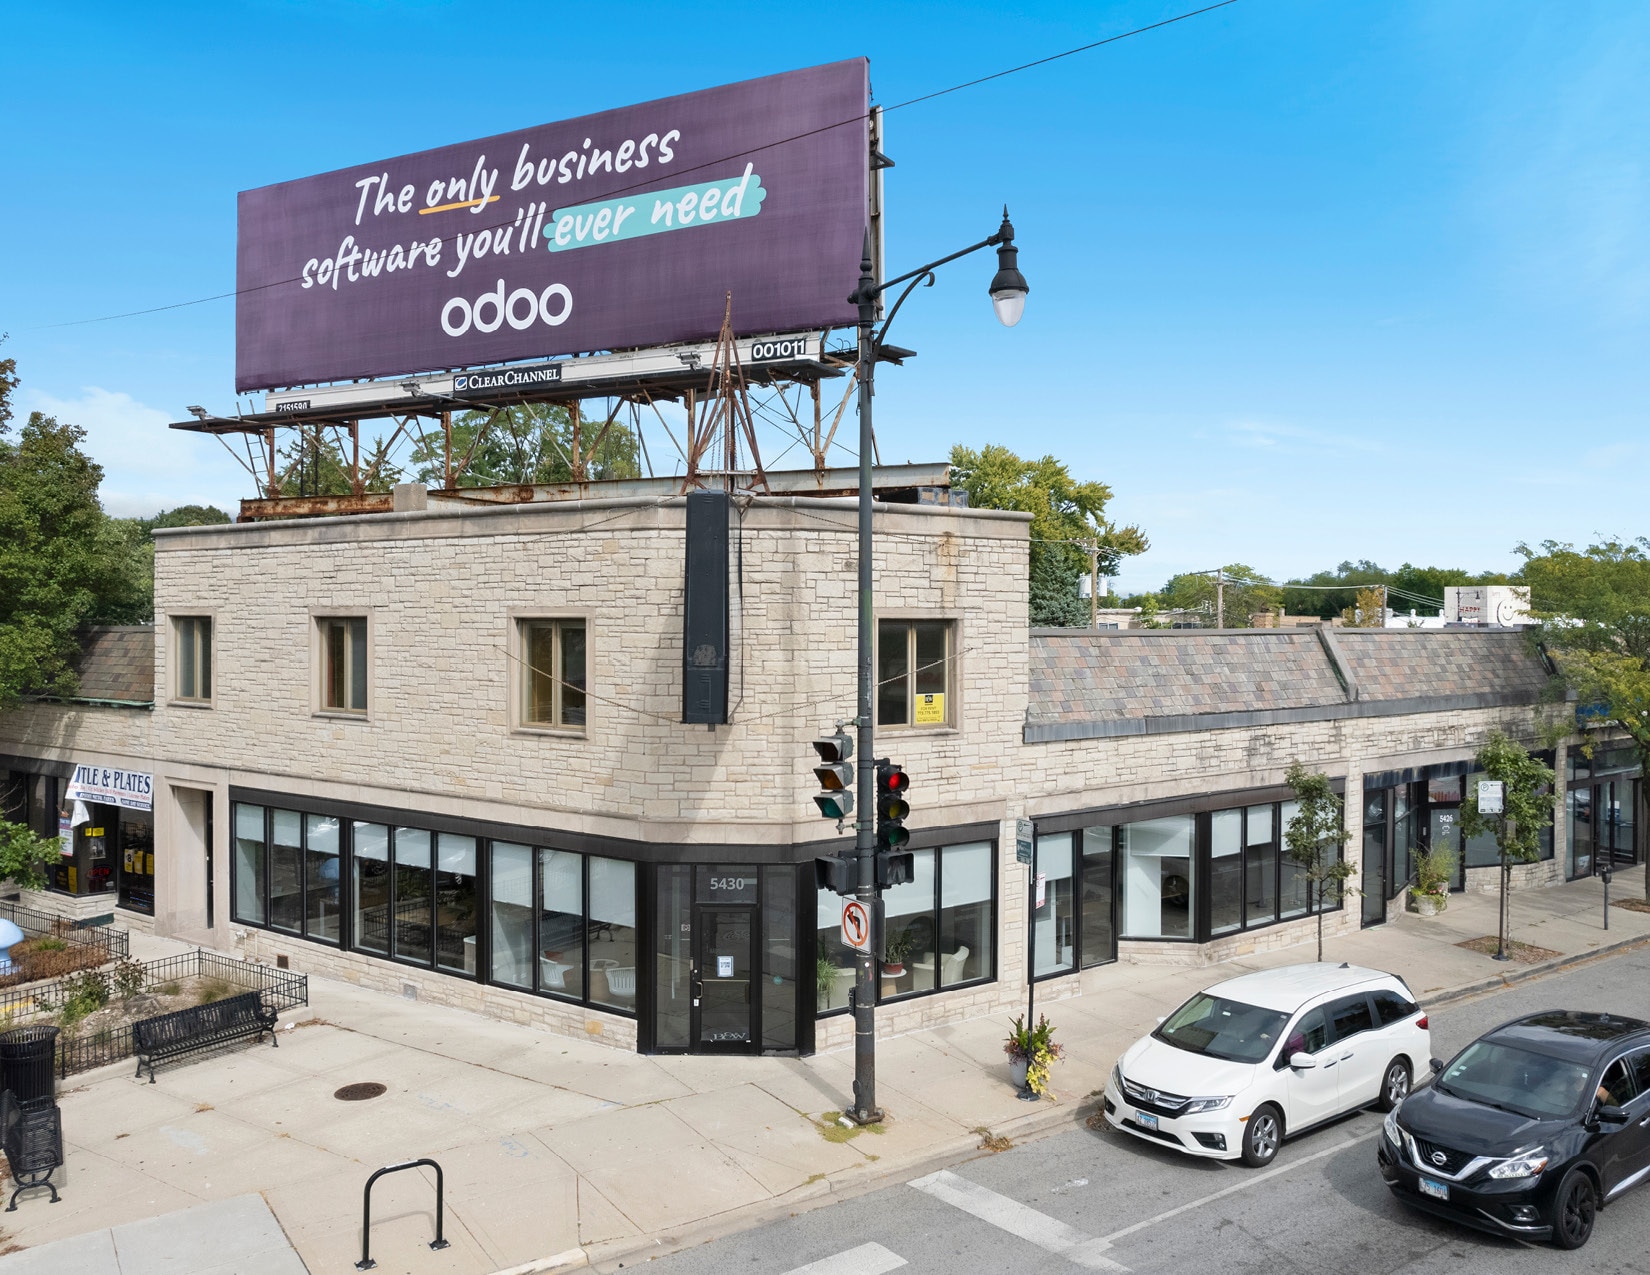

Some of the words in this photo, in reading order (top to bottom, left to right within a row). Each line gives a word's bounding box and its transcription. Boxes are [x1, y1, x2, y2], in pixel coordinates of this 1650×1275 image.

[355, 172, 415, 226] The
[425, 154, 499, 214] only
[510, 129, 681, 191] business
[301, 235, 443, 291] software
[446, 201, 547, 278] you'll
[554, 204, 636, 247] ever
[650, 161, 754, 227] need
[440, 278, 573, 337] odoo
[752, 340, 805, 359] 001011
[101, 769, 110, 788] &
[113, 771, 151, 794] PLATES
[710, 877, 744, 890] 5430
